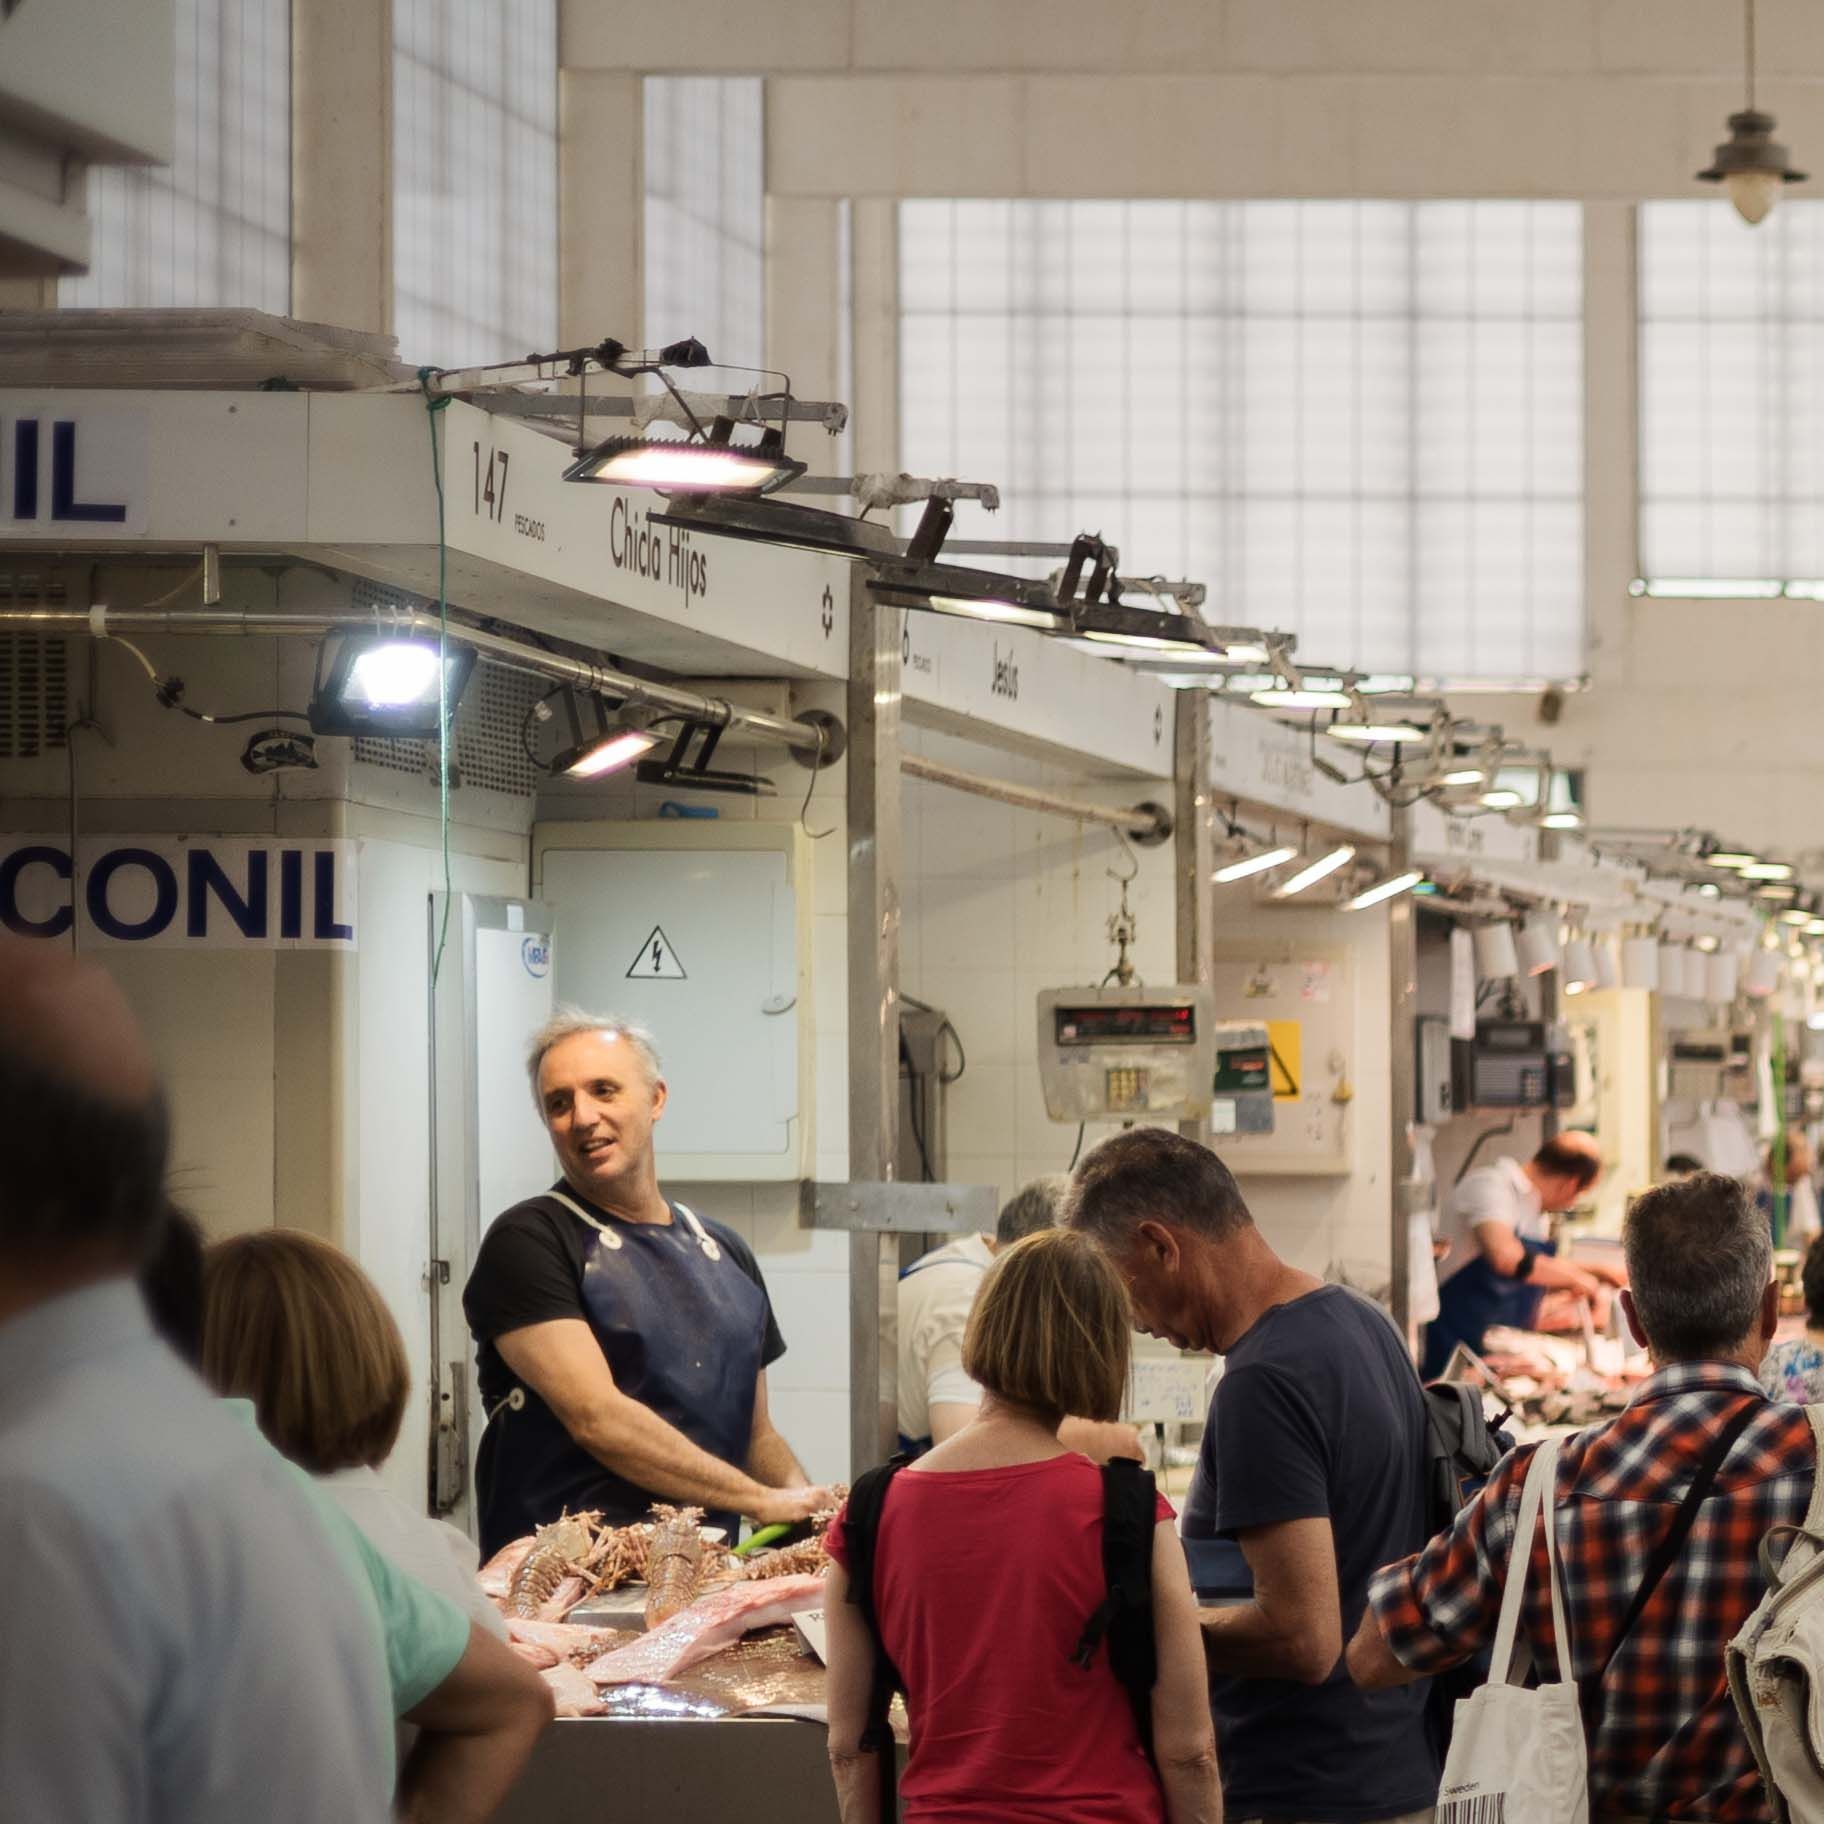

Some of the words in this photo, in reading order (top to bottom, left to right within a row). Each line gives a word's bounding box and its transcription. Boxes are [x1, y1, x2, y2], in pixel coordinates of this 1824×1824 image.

[474, 441, 509, 523] 147
[514, 513, 545, 541] PESCADOS
[668, 525, 707, 609] Hijos
[0, 846, 353, 941] CONIL
[1444, 1781, 1480, 1797] Sweden
